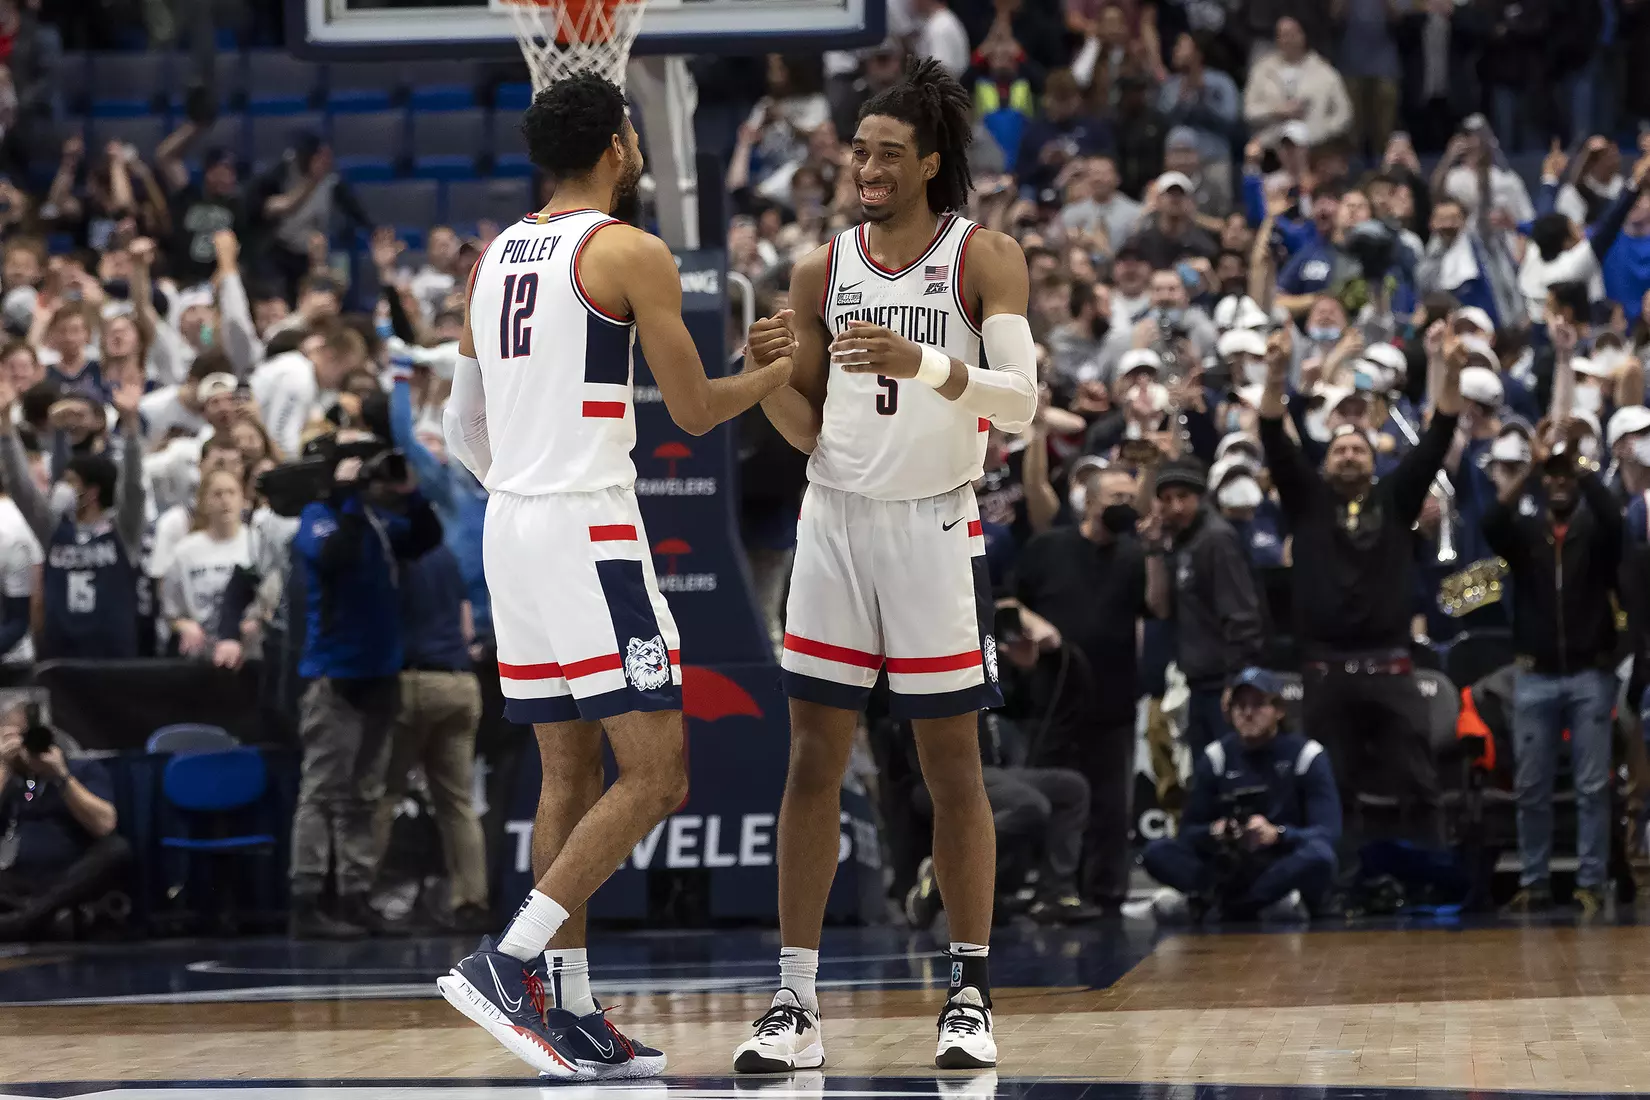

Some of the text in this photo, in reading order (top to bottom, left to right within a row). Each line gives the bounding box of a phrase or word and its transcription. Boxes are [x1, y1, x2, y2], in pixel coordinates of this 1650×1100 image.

[499, 235, 562, 264] POLLEY
[500, 272, 539, 359] 12
[876, 374, 898, 415] 5
